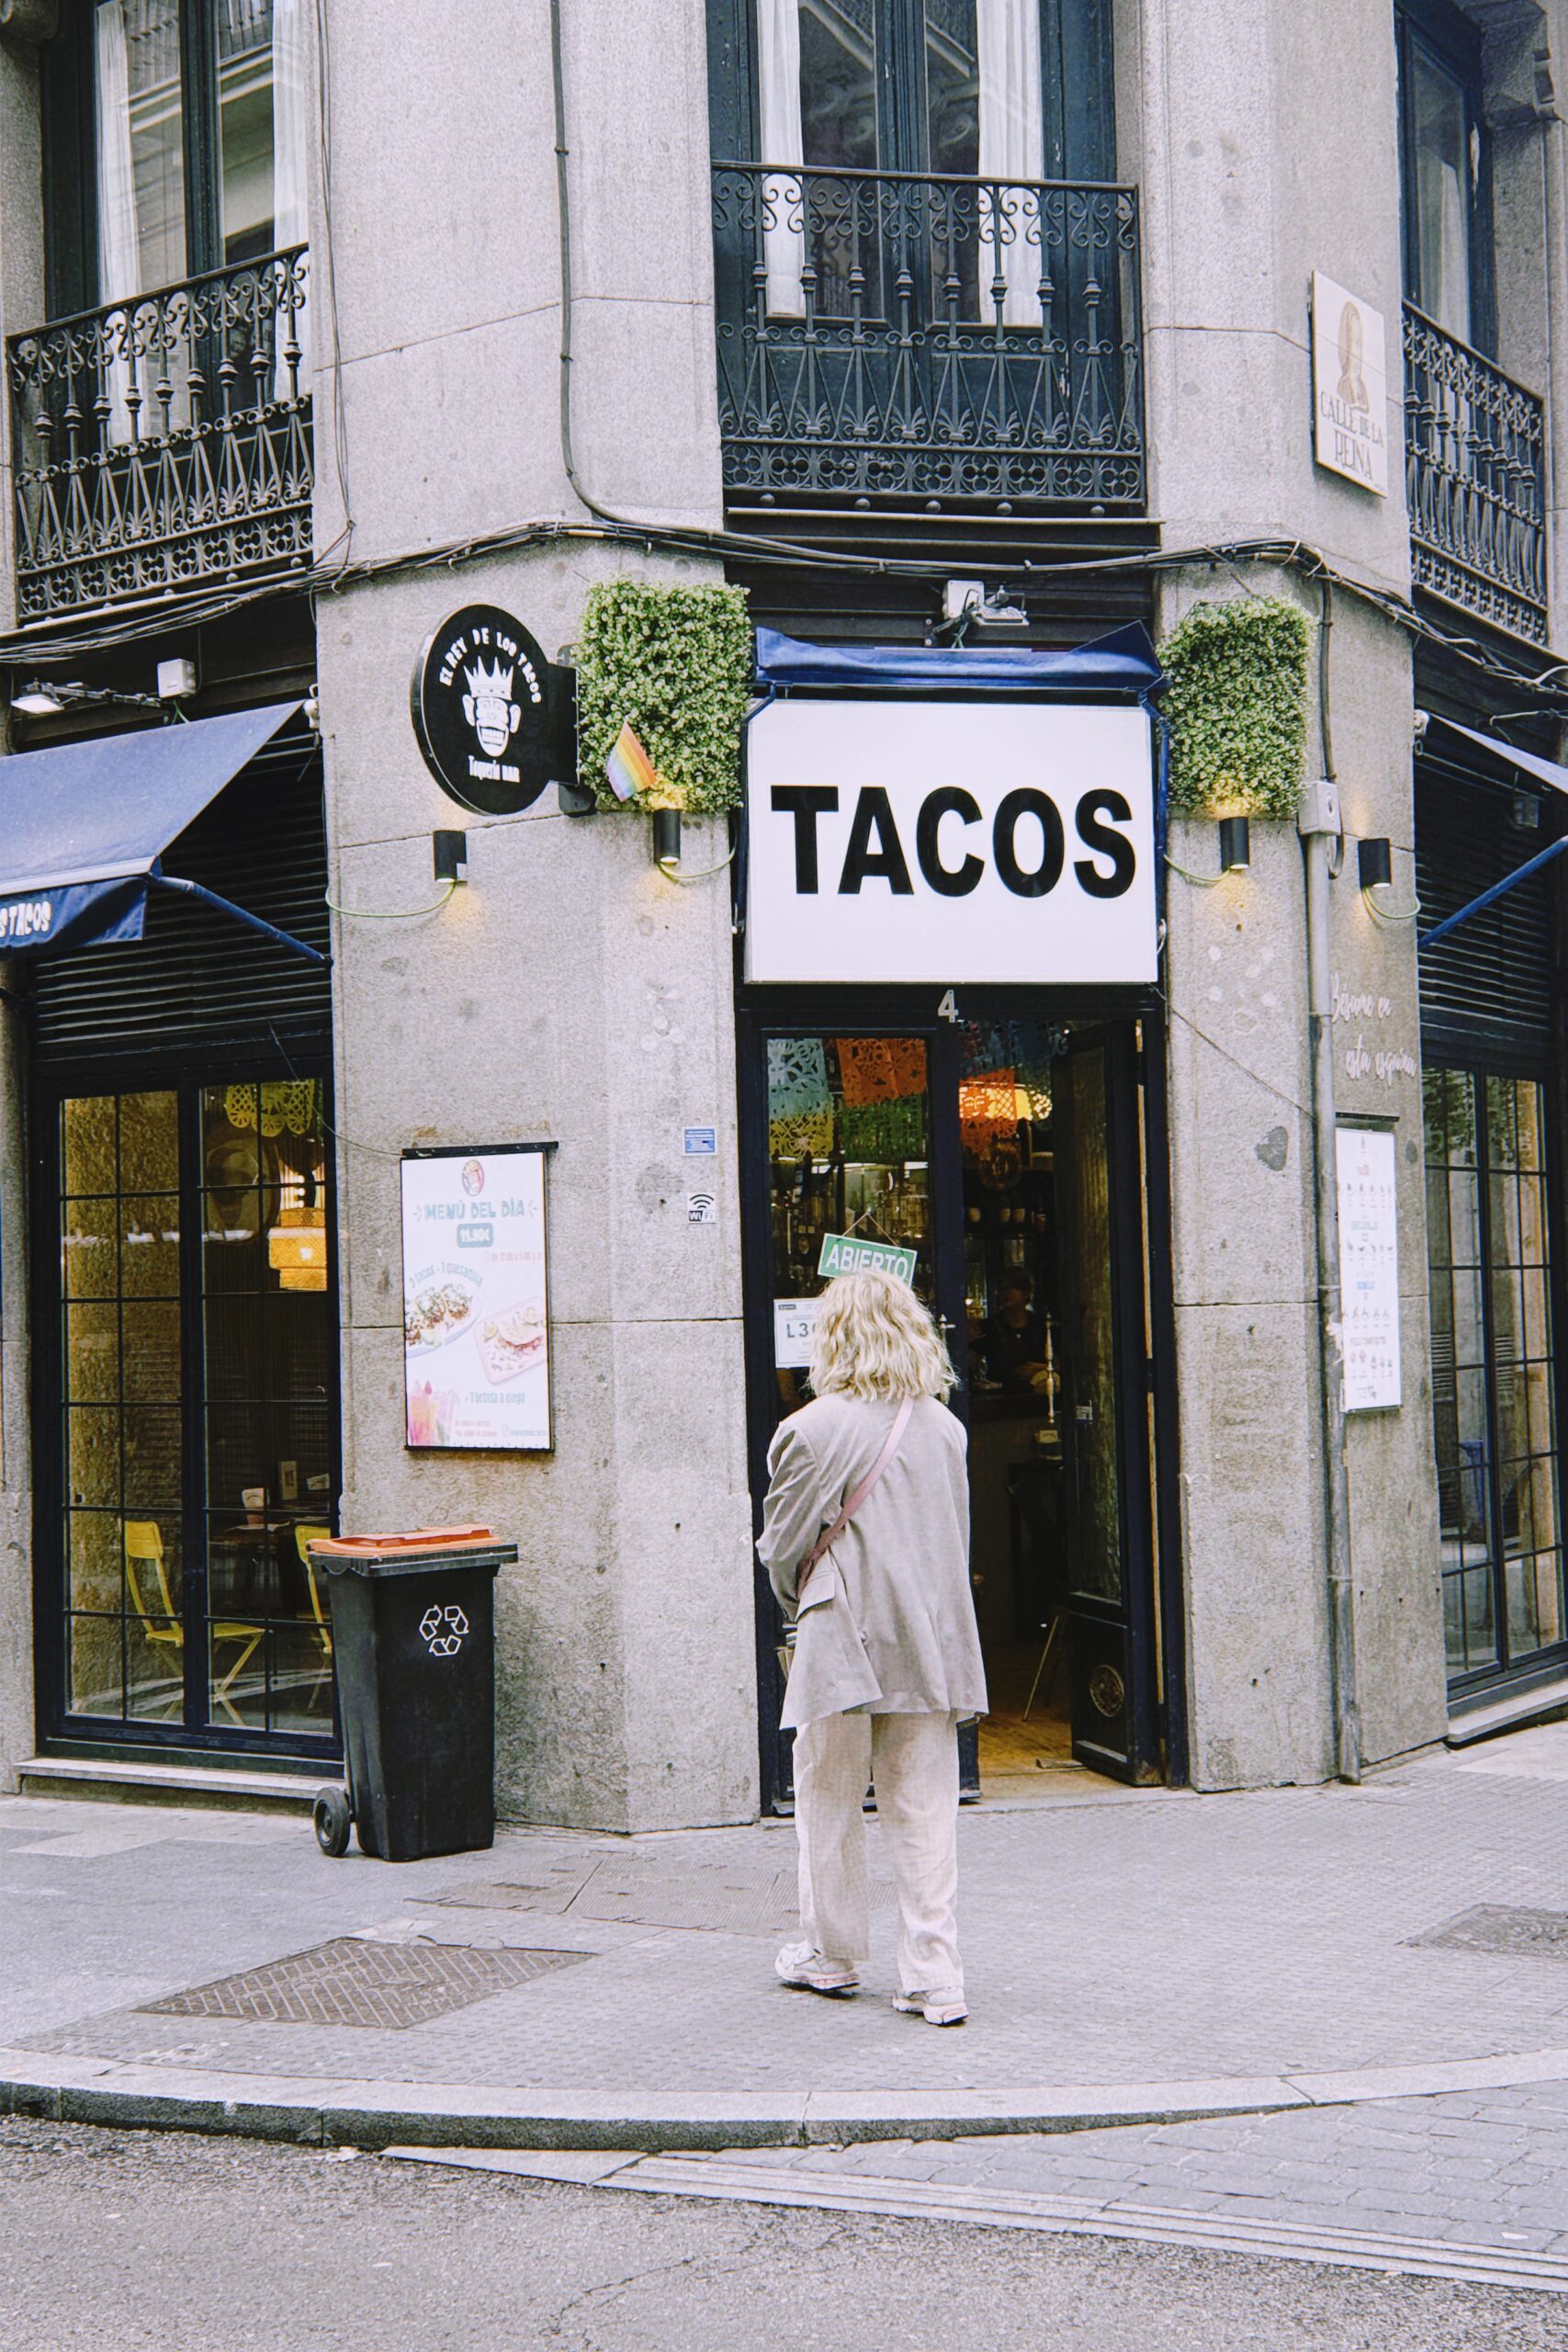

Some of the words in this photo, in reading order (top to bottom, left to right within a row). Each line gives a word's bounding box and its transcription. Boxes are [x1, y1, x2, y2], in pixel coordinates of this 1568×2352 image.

[1320, 390, 1357, 435] CALLE
[1359, 415, 1371, 439] DE
[1371, 423, 1384, 448] LA
[1334, 428, 1373, 481] REINA
[445, 636, 468, 669] REY
[471, 628, 490, 646] DE
[496, 631, 518, 657] LOS
[439, 666, 454, 687] EL
[517, 652, 542, 704] TACOS
[770, 785, 1137, 899] TACOS
[9, 900, 51, 936] TACOS
[937, 989, 958, 1023] 4
[424, 1199, 466, 1220] MENÚ
[471, 1202, 496, 1218] DEL
[502, 1197, 525, 1217] DÍA
[825, 1243, 908, 1282] ABIERTO
